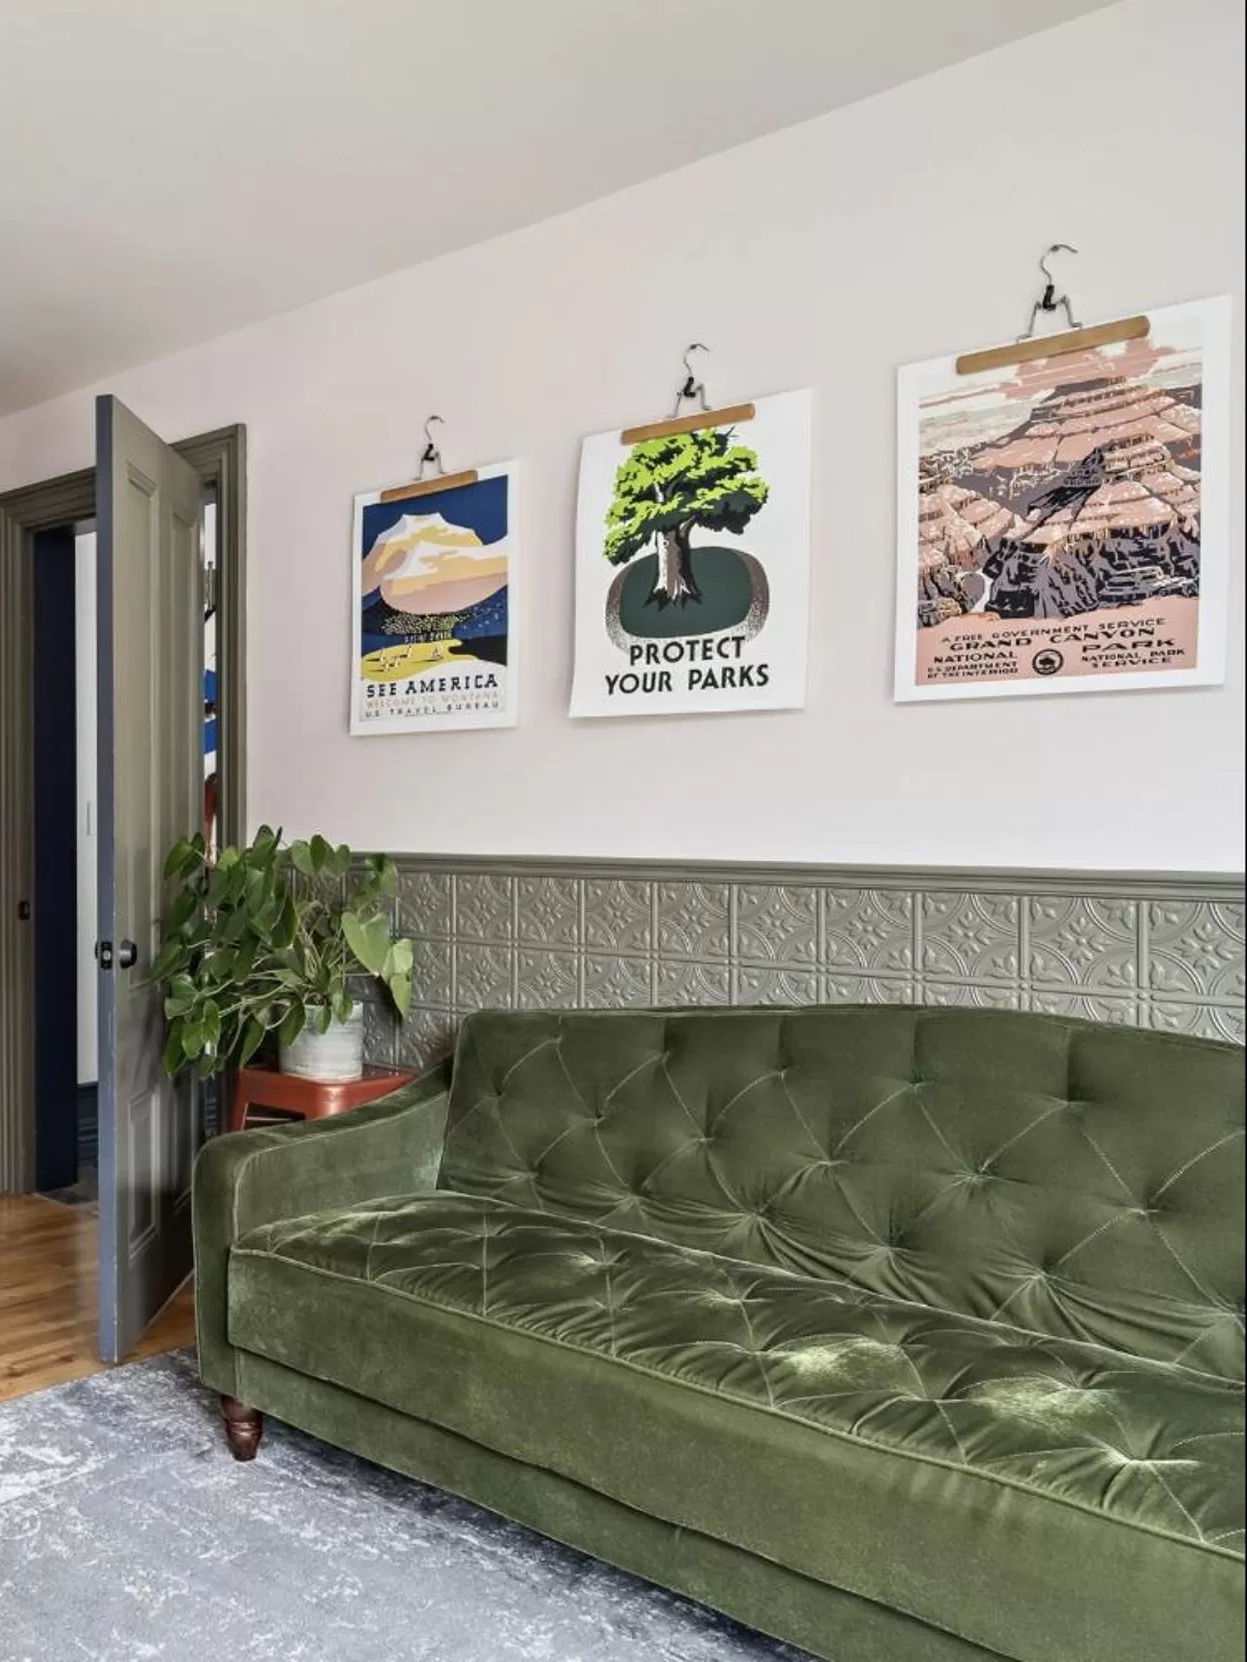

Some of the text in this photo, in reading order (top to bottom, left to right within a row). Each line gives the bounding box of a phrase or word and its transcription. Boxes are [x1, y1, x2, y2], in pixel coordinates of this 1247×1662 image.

[950, 628, 1155, 651] GRAND CANYON
[955, 633, 983, 642] FREE
[992, 625, 1089, 639] GOVERNMENT
[1099, 618, 1166, 630] SERVICE
[630, 636, 745, 666] PROTECT
[934, 639, 1175, 663] NATIONAL PARK
[1081, 649, 1185, 662] NATIONAL PARK
[1092, 657, 1172, 668] SERVICE
[367, 673, 499, 698] SEE AMERICA
[605, 664, 769, 695] YOUR PARKS
[446, 701, 499, 712] BUREAU
